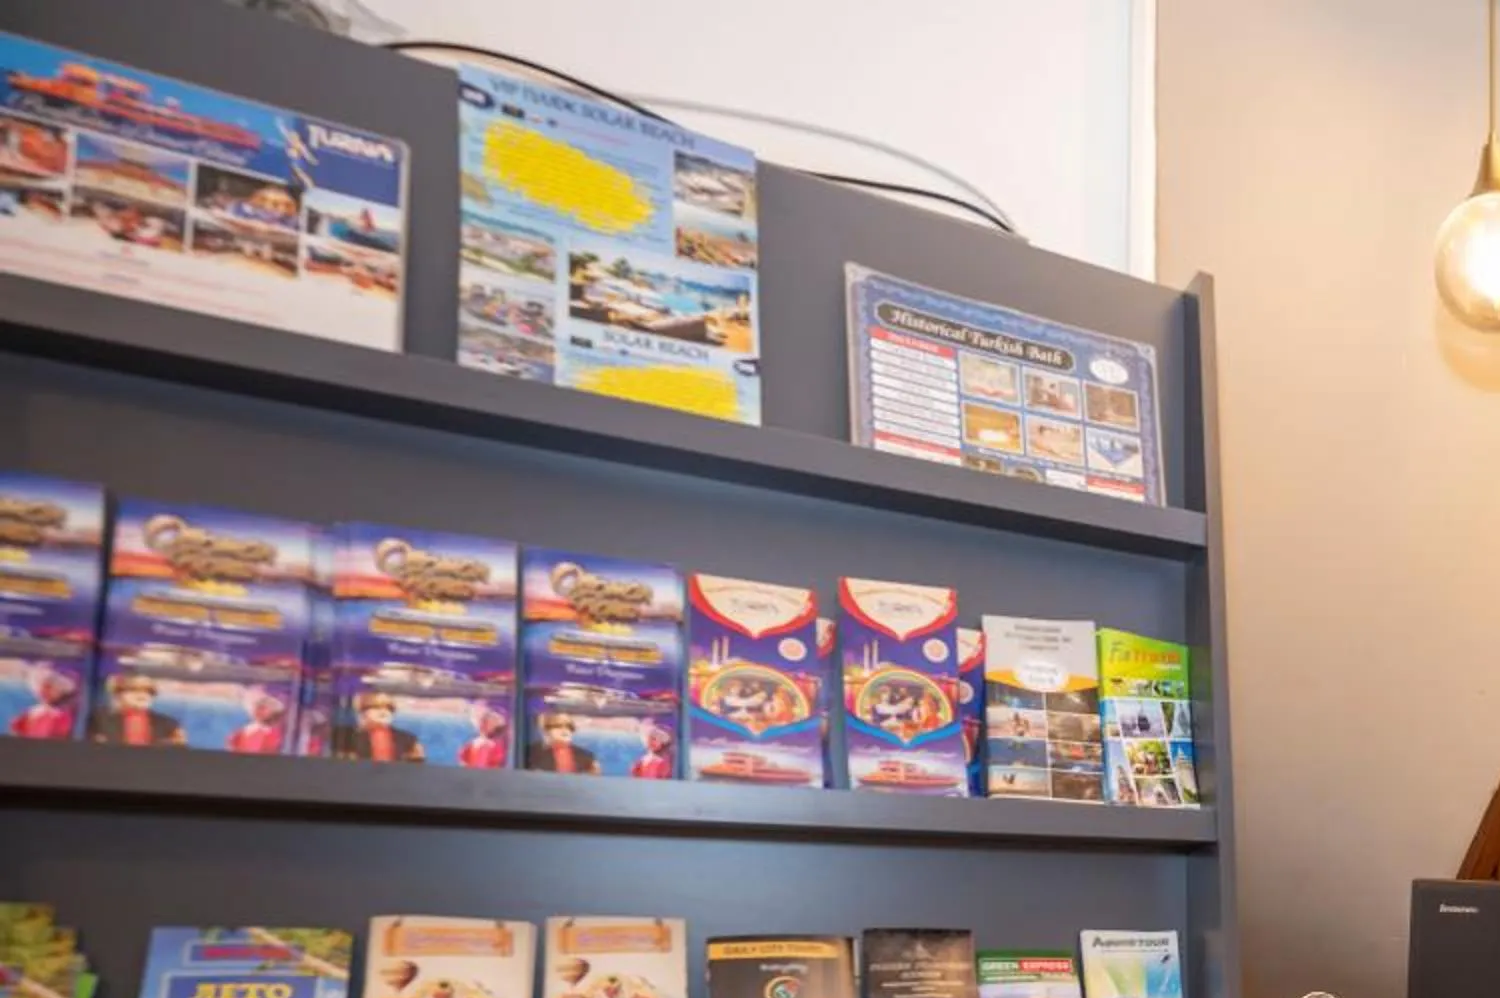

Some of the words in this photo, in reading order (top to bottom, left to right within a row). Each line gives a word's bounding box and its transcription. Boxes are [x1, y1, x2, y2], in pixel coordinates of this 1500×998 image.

[891, 308, 969, 342] Historical
[969, 330, 1024, 357] Turkish
[1027, 345, 1063, 366] Bath
[980, 961, 1019, 973] GREEN
[1022, 960, 1071, 972] EXPRESS
